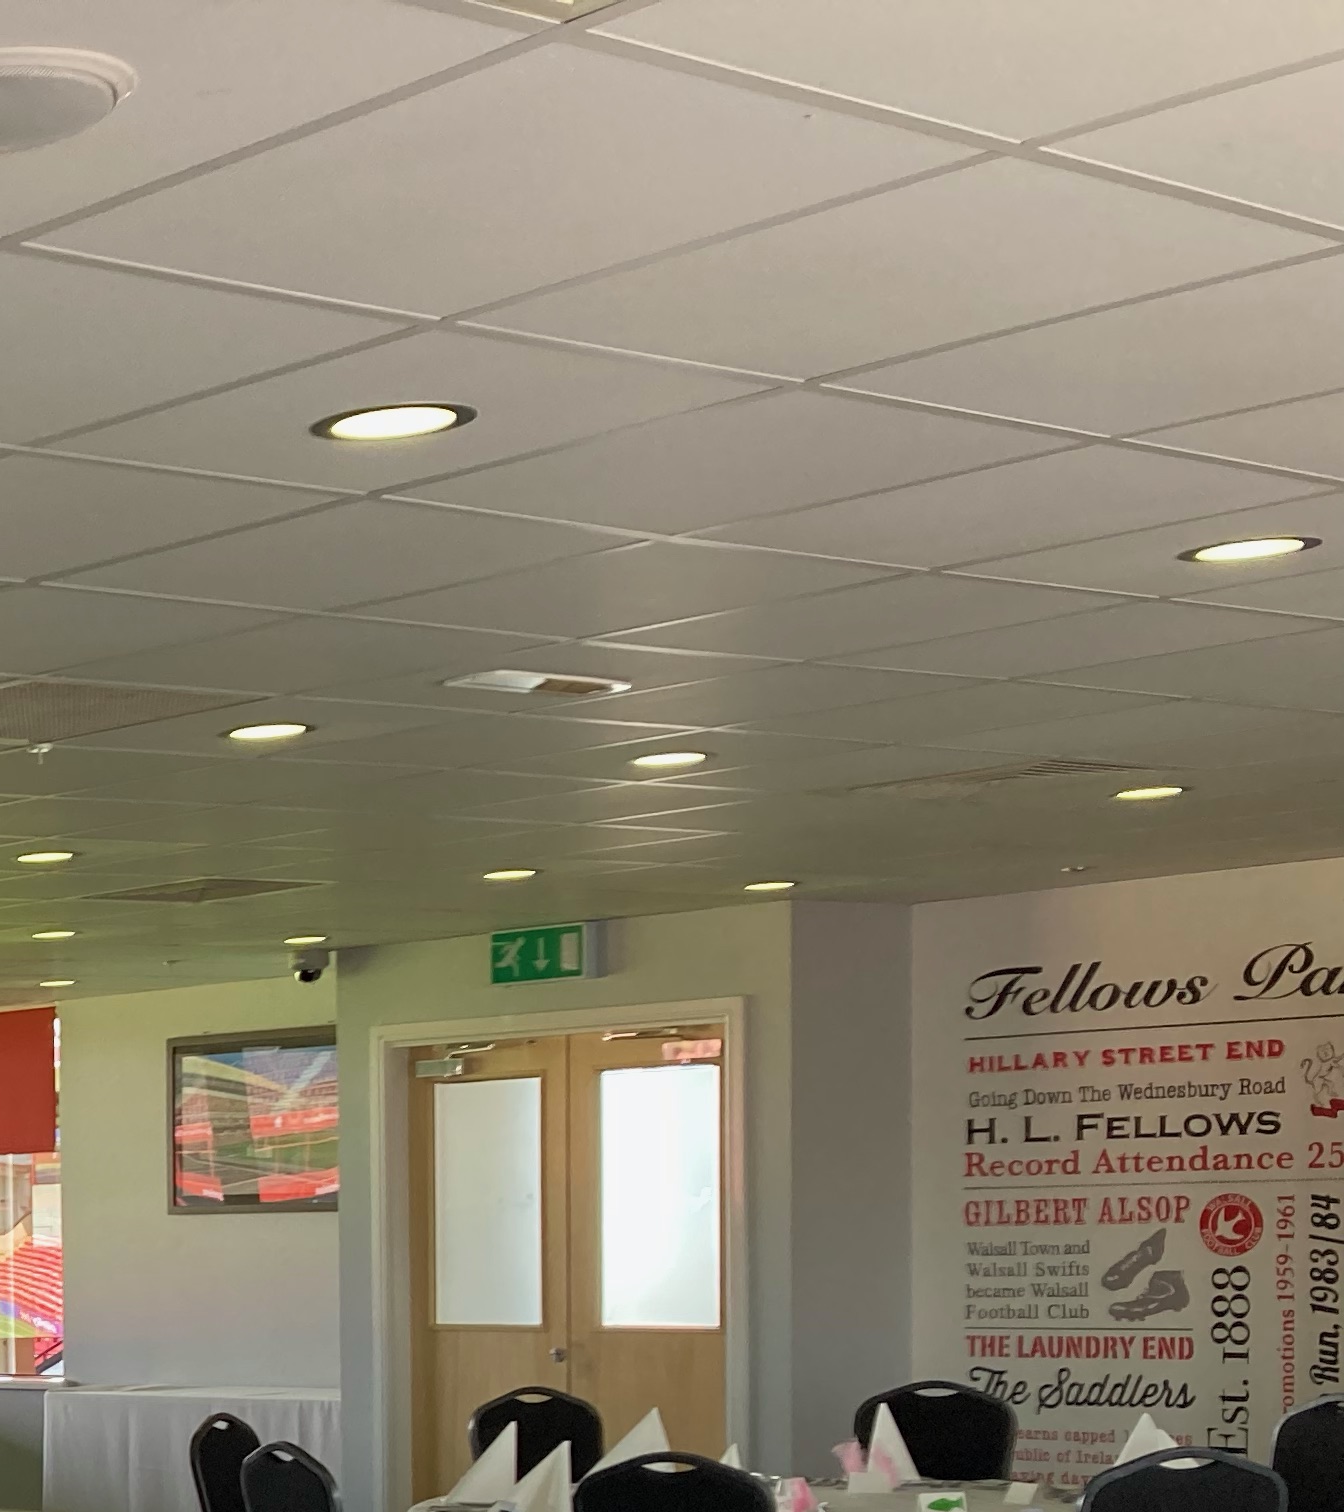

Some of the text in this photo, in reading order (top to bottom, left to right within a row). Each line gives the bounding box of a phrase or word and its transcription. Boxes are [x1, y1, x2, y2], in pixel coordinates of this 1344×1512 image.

[964, 941, 1344, 1021] Fellows Pa
[967, 1039, 1286, 1073] HILLARY STREET END
[968, 1076, 1286, 1109] Going Down The Wednesbury Road
[965, 1110, 1282, 1145] H. L. FELLOWS
[963, 1149, 1081, 1178] Record
[1092, 1144, 1294, 1176] Attendance
[964, 1195, 1191, 1227] GILBERT ALSOP
[966, 1239, 1091, 1257] Walsall Town and
[1275, 1193, 1296, 1302] 1959-1961
[966, 1261, 1090, 1278] Walsall Swifts
[966, 1282, 1089, 1299] became Walsall
[965, 1303, 1090, 1320] Football Club
[965, 1335, 1195, 1361] THE LAUNDRY END
[1280, 1308, 1296, 1414] romotions
[968, 1365, 1197, 1416] The Saddlers
[1207, 1379, 1250, 1457] Est.
[1017, 1430, 1058, 1441] earns
[1064, 1429, 1116, 1445] capped
[1056, 1449, 1072, 1463] of
[1074, 1450, 1119, 1465] Irela
